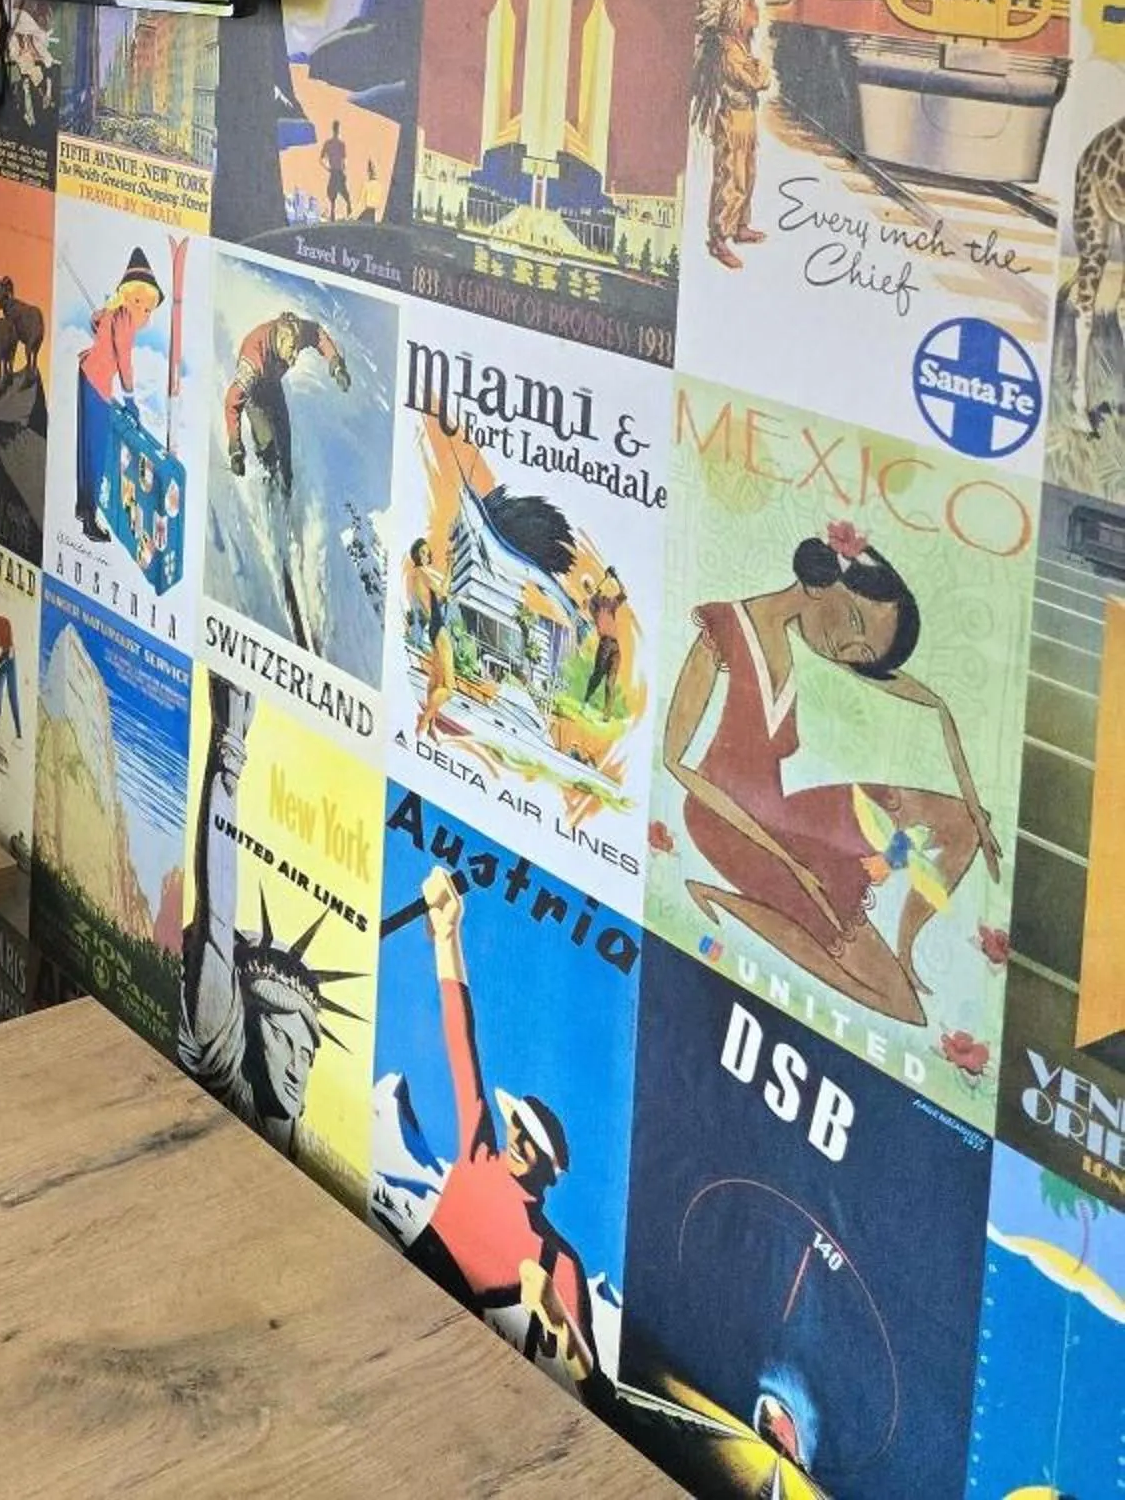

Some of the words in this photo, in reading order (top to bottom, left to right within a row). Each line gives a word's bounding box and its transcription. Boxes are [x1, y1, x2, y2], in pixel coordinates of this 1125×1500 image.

[60, 141, 91, 166] FIFTH
[175, 170, 209, 195] YORK
[79, 183, 121, 210] TRAVEL
[140, 199, 182, 226] TRAIN
[295, 236, 337, 265] Travel
[341, 246, 360, 273] by
[364, 255, 402, 284] Train
[778, 176, 870, 247] Every
[878, 220, 955, 257] inch
[963, 229, 1032, 277] the
[456, 277, 520, 320] CENTURY
[523, 295, 542, 325] OF
[548, 302, 631, 349] PROGRESS
[804, 243, 919, 316] Chief
[404, 340, 600, 442] Miami
[614, 414, 650, 458] &
[918, 358, 999, 403] Santa
[999, 379, 1037, 417] Fe
[463, 410, 514, 458] Fort
[520, 429, 668, 509] Lauderdale
[673, 389, 1032, 558] MEXICO
[144, 649, 189, 686] SERVICE
[206, 615, 374, 737] SWITZERLAND
[270, 762, 318, 846] New
[321, 787, 371, 885] York
[415, 743, 488, 794] DELTA
[498, 789, 544, 825] AIR
[554, 818, 641, 878] LINES
[213, 813, 277, 868] UNITED
[277, 857, 311, 895] AIR
[313, 886, 370, 934] LINES
[386, 789, 641, 977] Austria
[737, 955, 928, 1085] UNITED
[720, 1002, 857, 1163] DSB
[811, 1231, 844, 1272] 140
